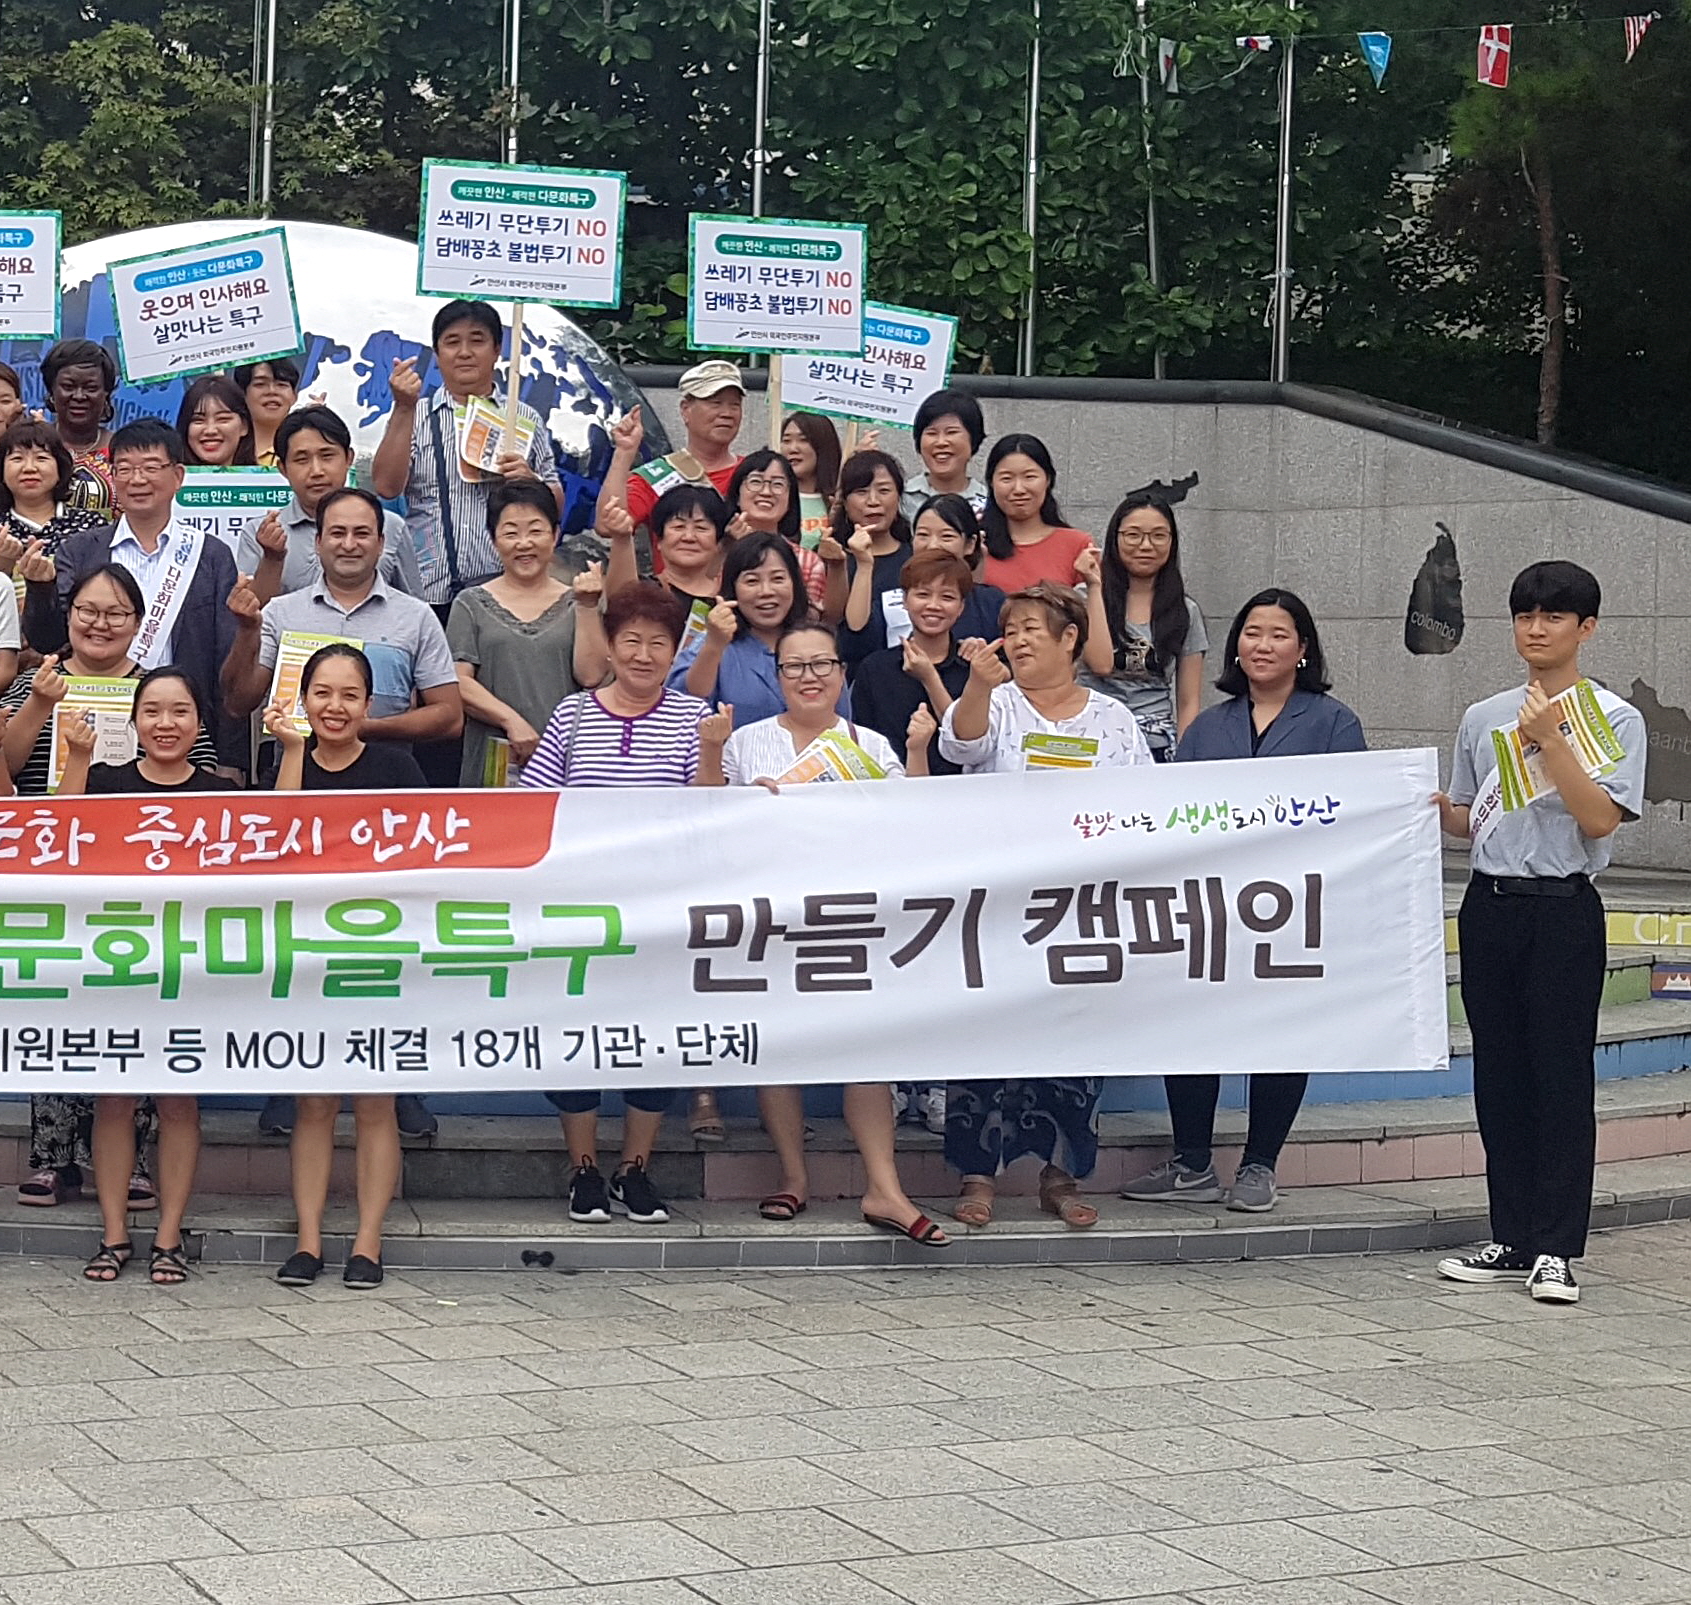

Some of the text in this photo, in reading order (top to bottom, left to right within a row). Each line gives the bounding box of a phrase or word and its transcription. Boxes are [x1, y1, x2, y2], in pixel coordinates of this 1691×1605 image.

[484, 186, 506, 199] 안산
[437, 210, 607, 237] 쓰레기 무단투기 NO
[436, 237, 605, 265] 담배꽁초 불법투기 NO
[705, 264, 852, 288] 쓰레기 무단투기 NO
[139, 278, 269, 321] 웃으며 인사해요
[705, 291, 852, 315] 담배꽁초 불법투기 NO
[153, 306, 263, 345] 살맛나는 특구
[863, 344, 927, 371] 인사해요
[808, 360, 914, 394] 살맛나는 특구
[210, 490, 232, 503] 안산
[176, 517, 219, 534] 레기
[1274, 795, 1341, 827] 안산
[124, 806, 323, 870] 중심도시
[350, 807, 471, 862] 안산
[686, 887, 988, 993] 만들기
[1022, 873, 1325, 986] 캠페인
[163, 1028, 207, 1074] 등
[225, 1030, 326, 1070] MOU
[344, 1026, 429, 1073] 체결
[451, 1025, 542, 1071] 18개
